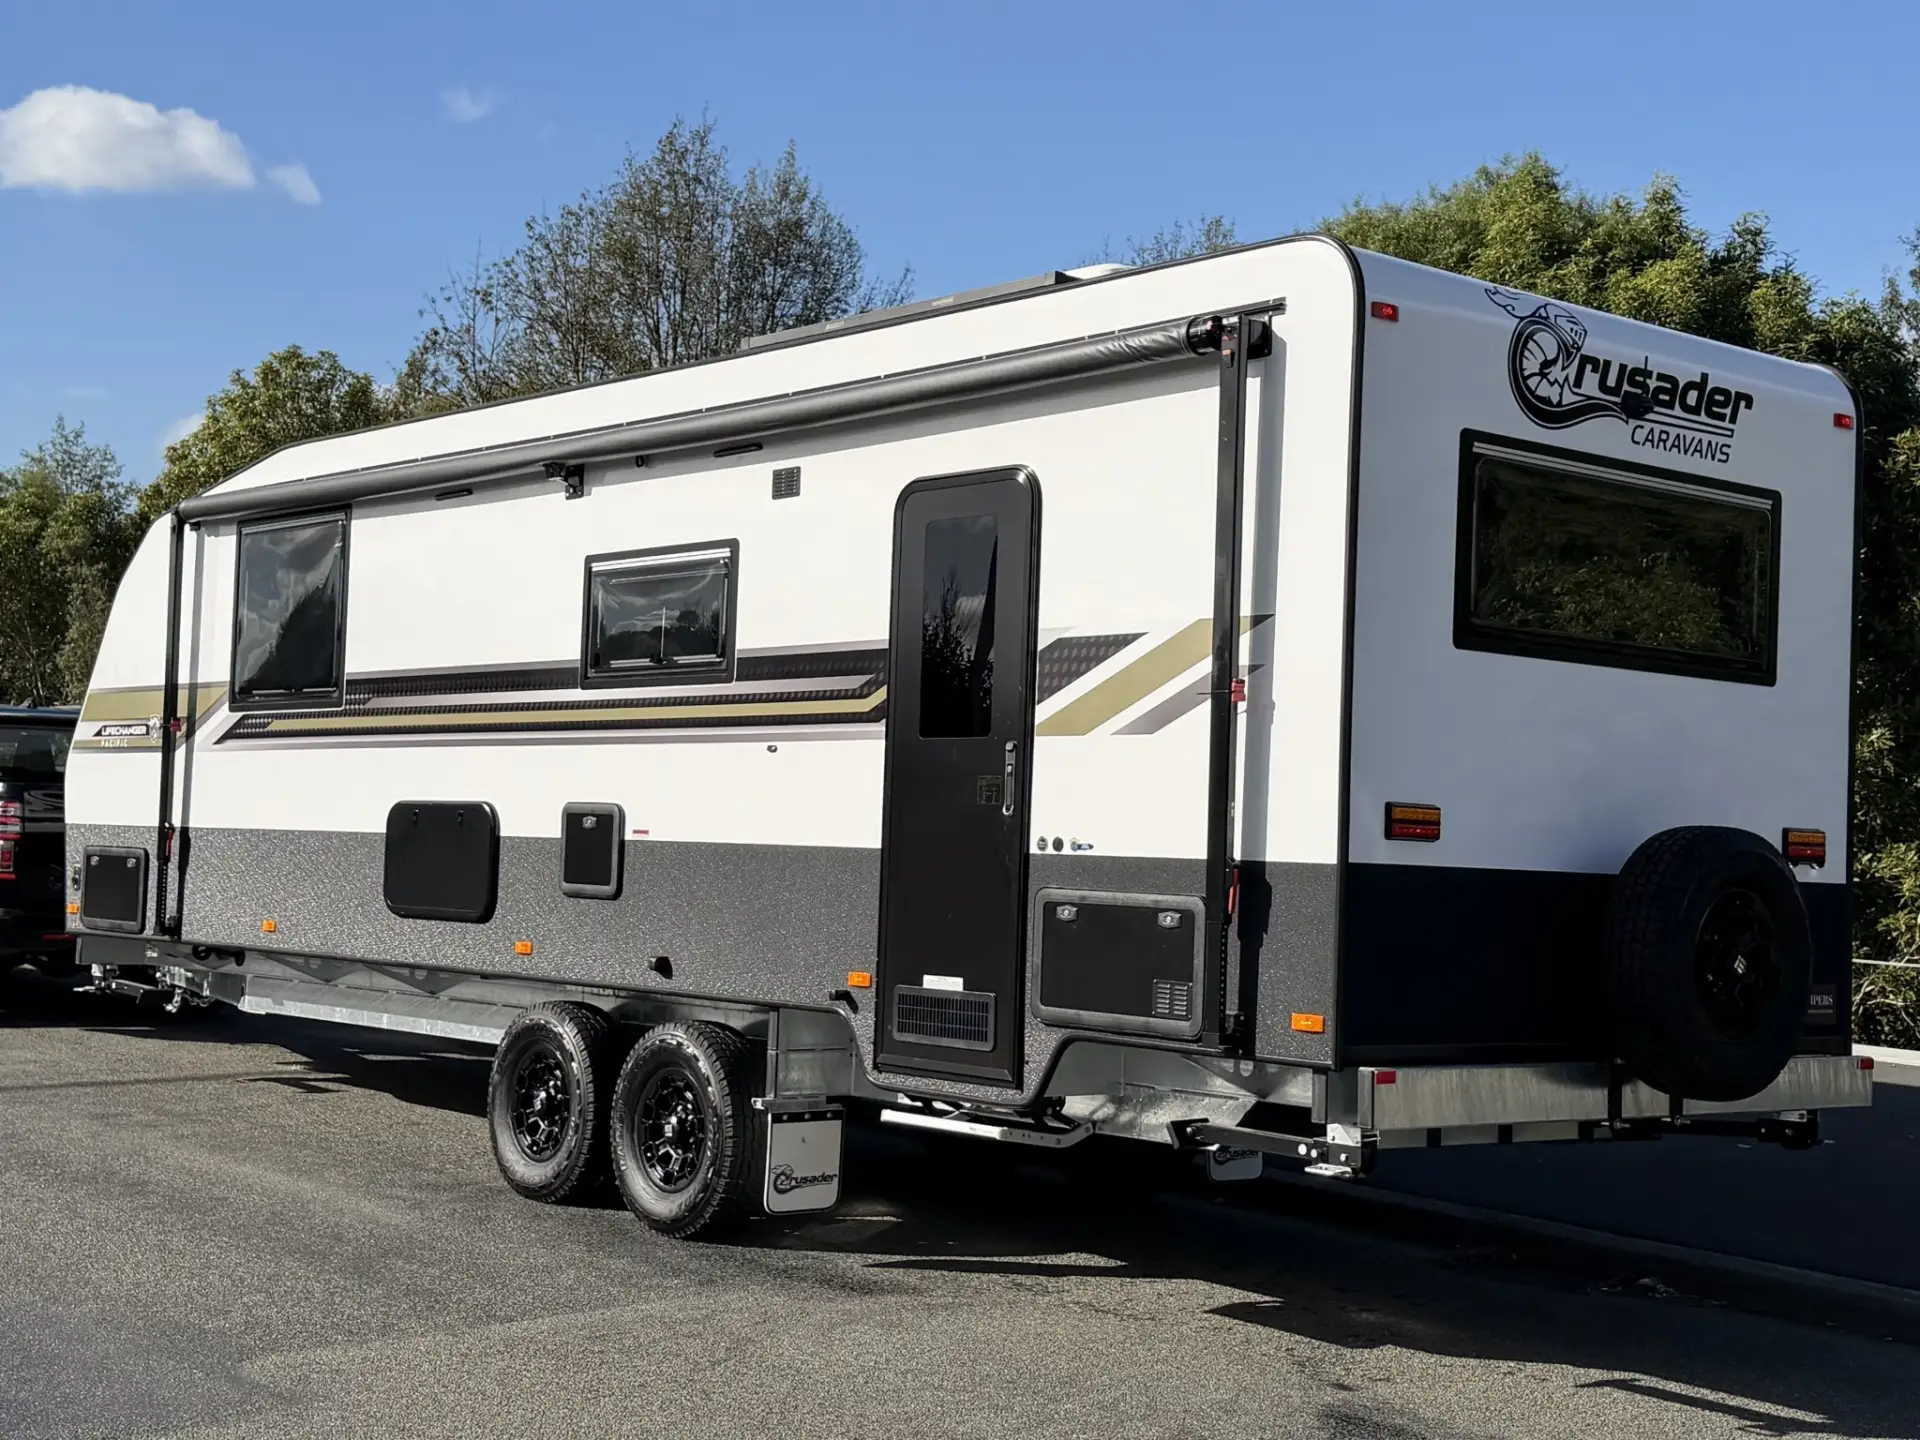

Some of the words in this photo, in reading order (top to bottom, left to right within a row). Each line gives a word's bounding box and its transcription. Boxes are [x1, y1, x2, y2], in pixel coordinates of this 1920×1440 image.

[1507, 305, 1754, 430] Crusader
[1630, 424, 1732, 464] CARAVANS
[773, 1171, 838, 1195] Crusader
